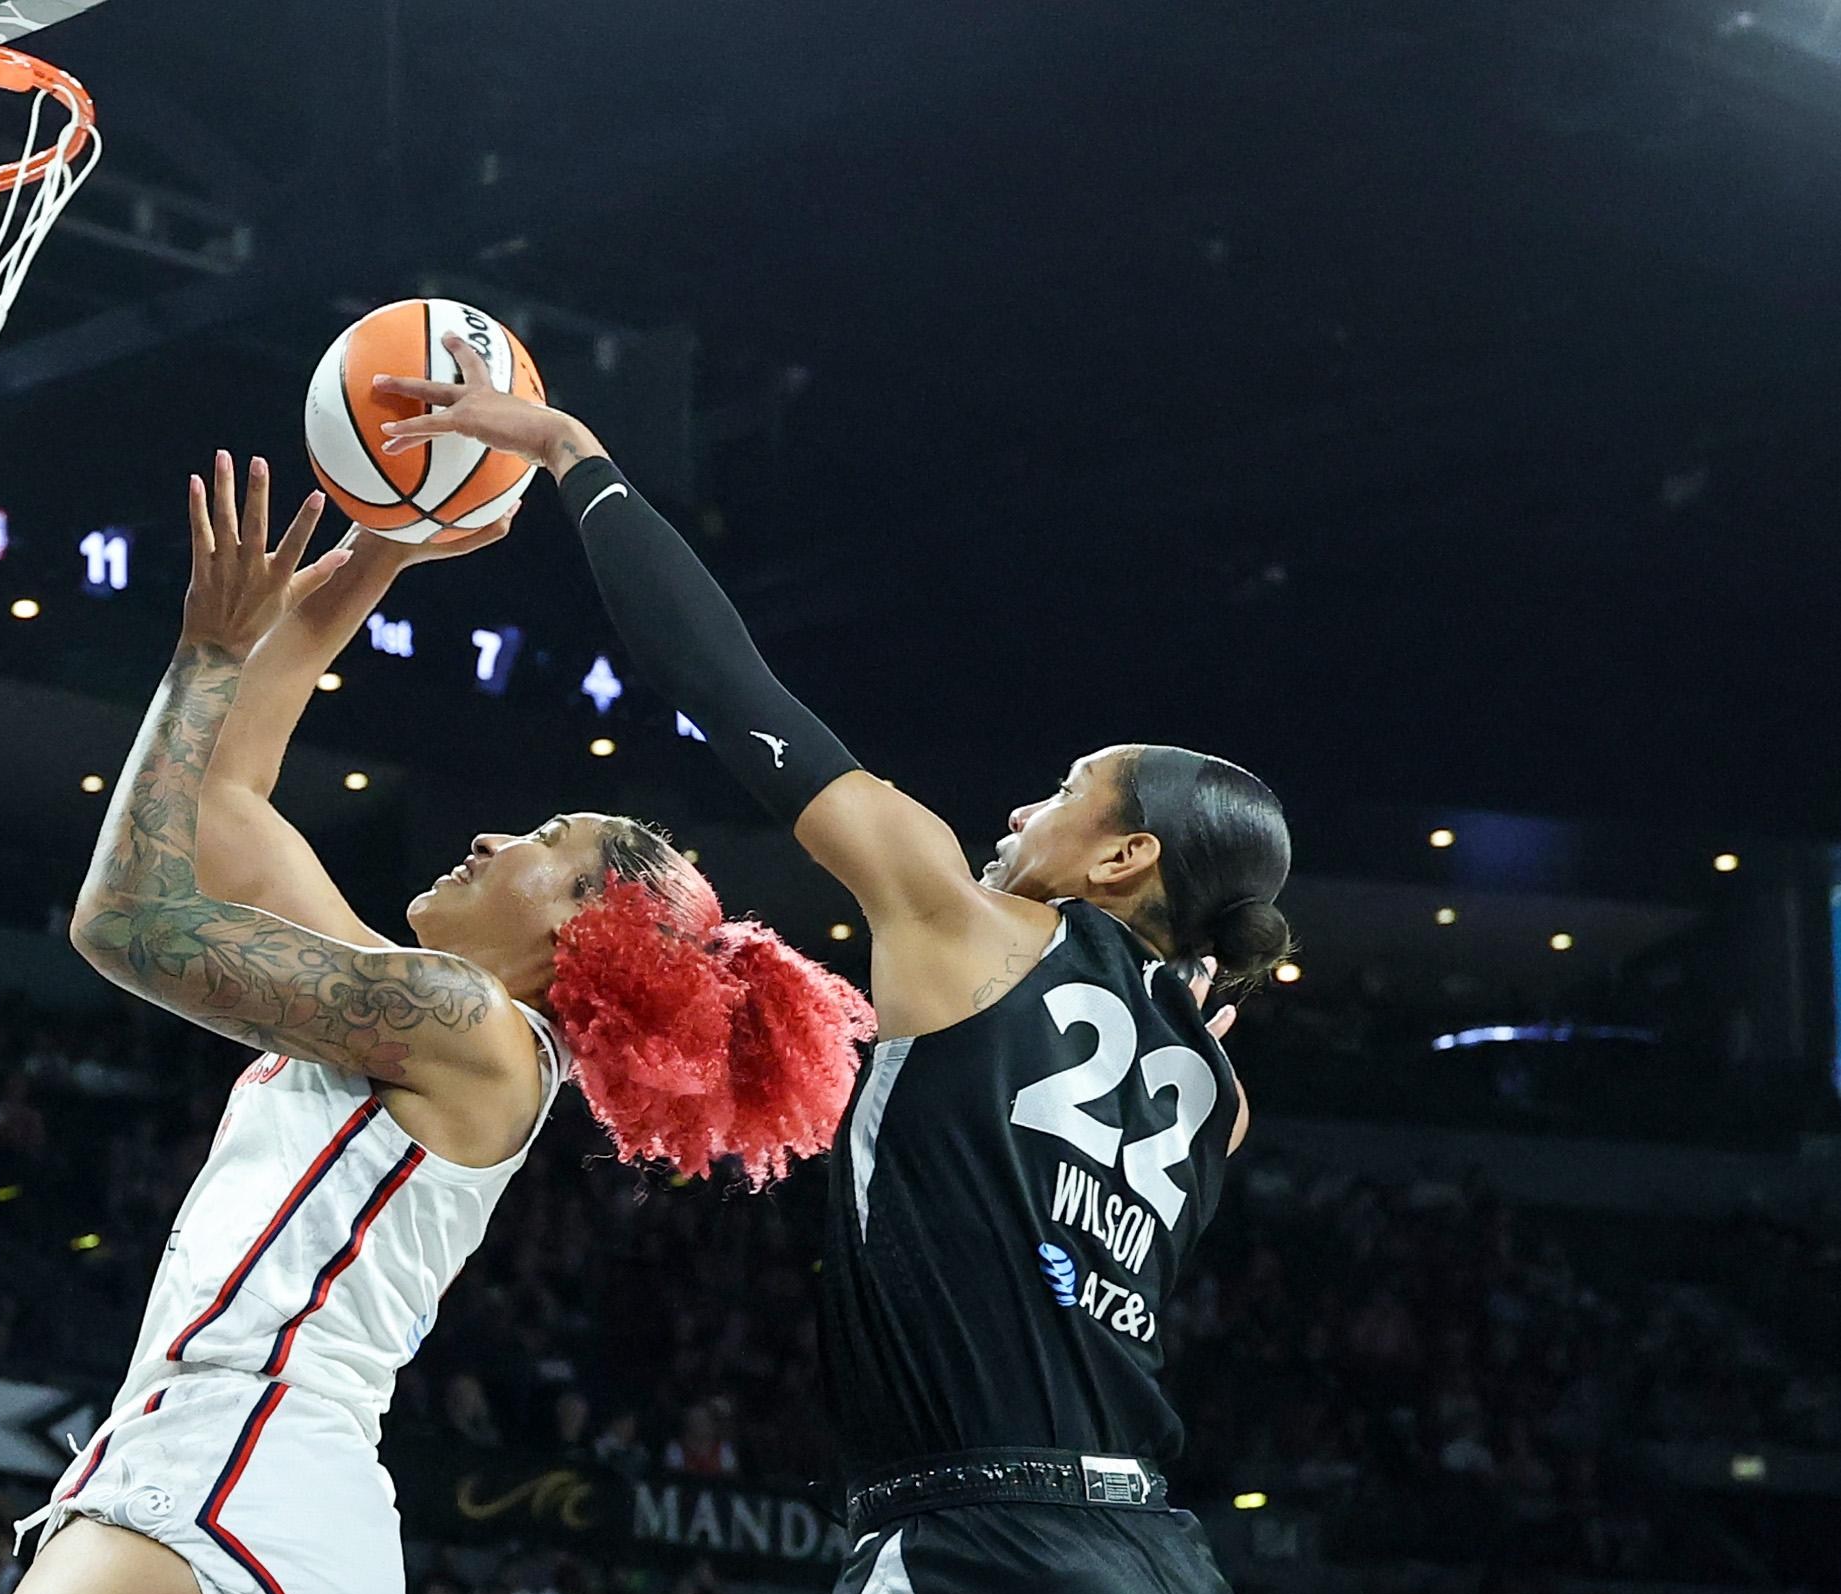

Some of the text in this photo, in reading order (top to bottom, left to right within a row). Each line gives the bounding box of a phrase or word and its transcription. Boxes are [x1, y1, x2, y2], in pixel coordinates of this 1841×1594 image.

[80, 531, 128, 590] 11
[472, 629, 501, 681] 7
[1010, 982, 1218, 1232] 22
[1051, 1161, 1156, 1275] WILSON
